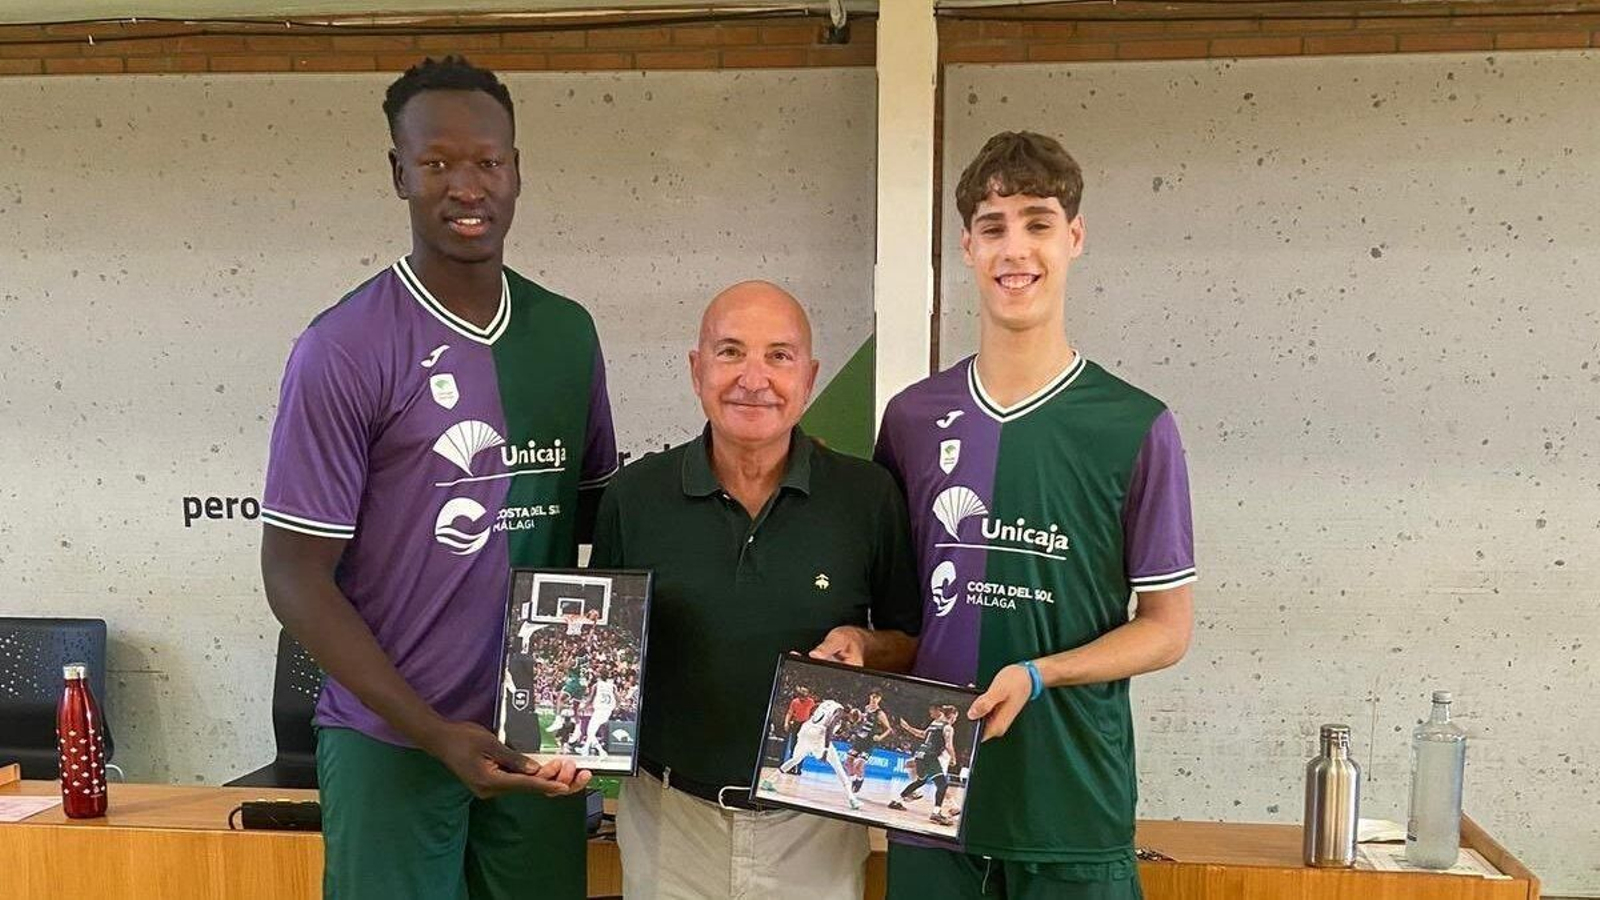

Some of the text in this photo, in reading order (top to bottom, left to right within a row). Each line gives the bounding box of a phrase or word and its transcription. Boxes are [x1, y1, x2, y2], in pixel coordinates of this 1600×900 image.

[183, 496, 260, 527] pero
[492, 518, 535, 533] MÁLAG
[981, 517, 1069, 553] Unicaja
[966, 592, 1017, 610] MÁLAGA
[967, 581, 1055, 604] COSTA DEL SOL
